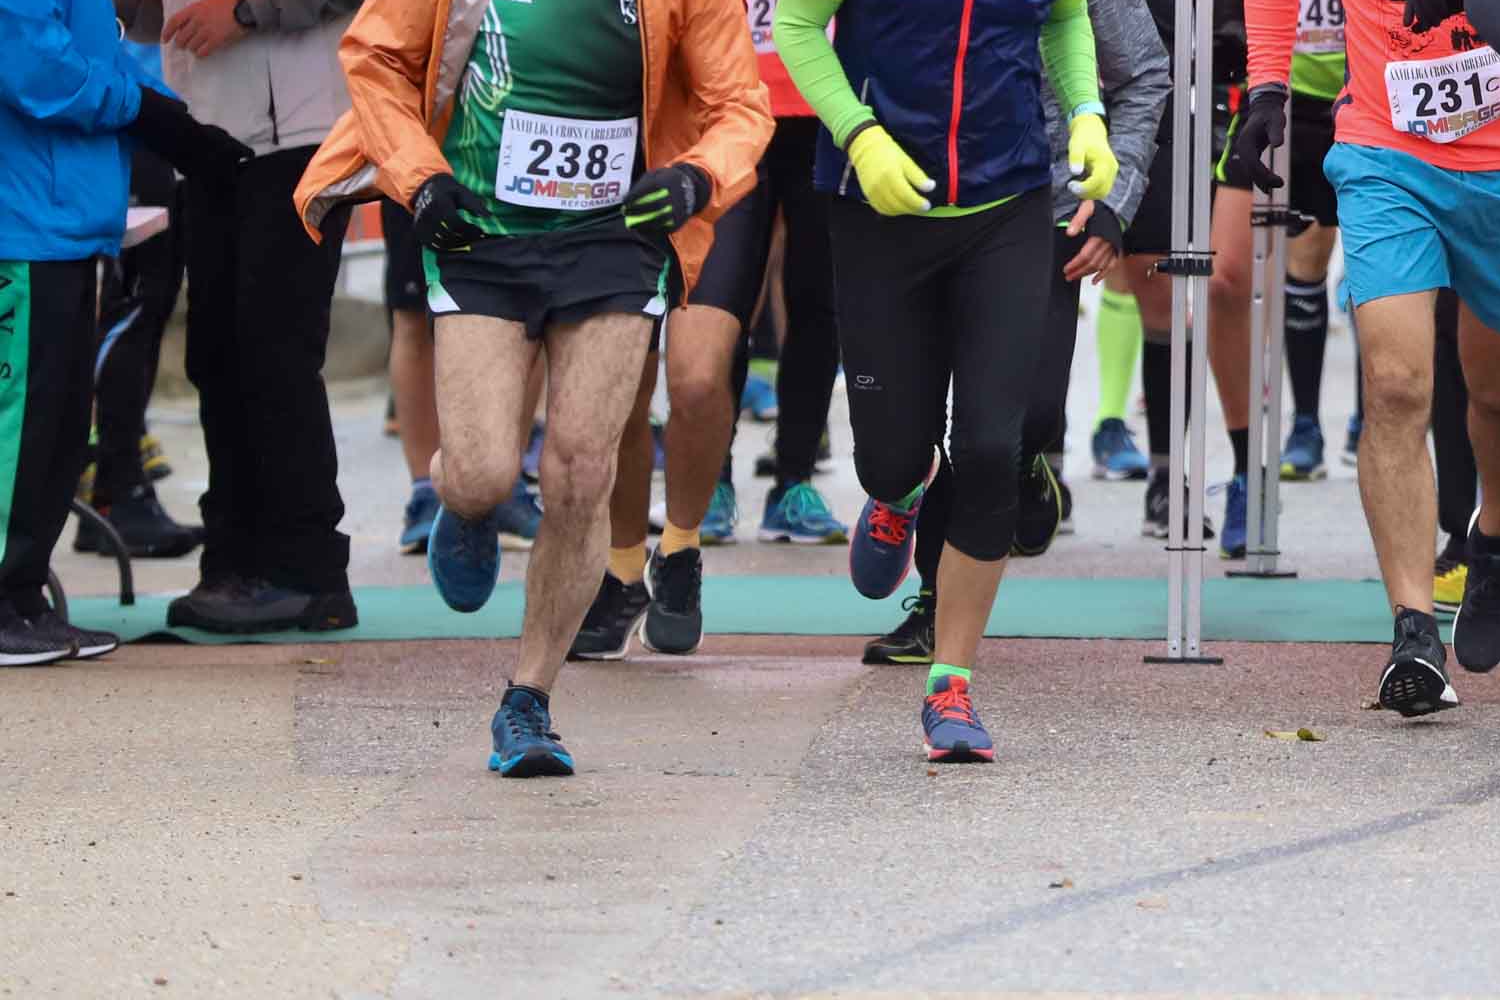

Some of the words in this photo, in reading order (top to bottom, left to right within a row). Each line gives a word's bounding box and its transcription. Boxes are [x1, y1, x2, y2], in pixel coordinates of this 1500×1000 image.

[1412, 72, 1483, 117] 231
[526, 139, 609, 180] 238
[505, 176, 621, 199] JOMISAGA
